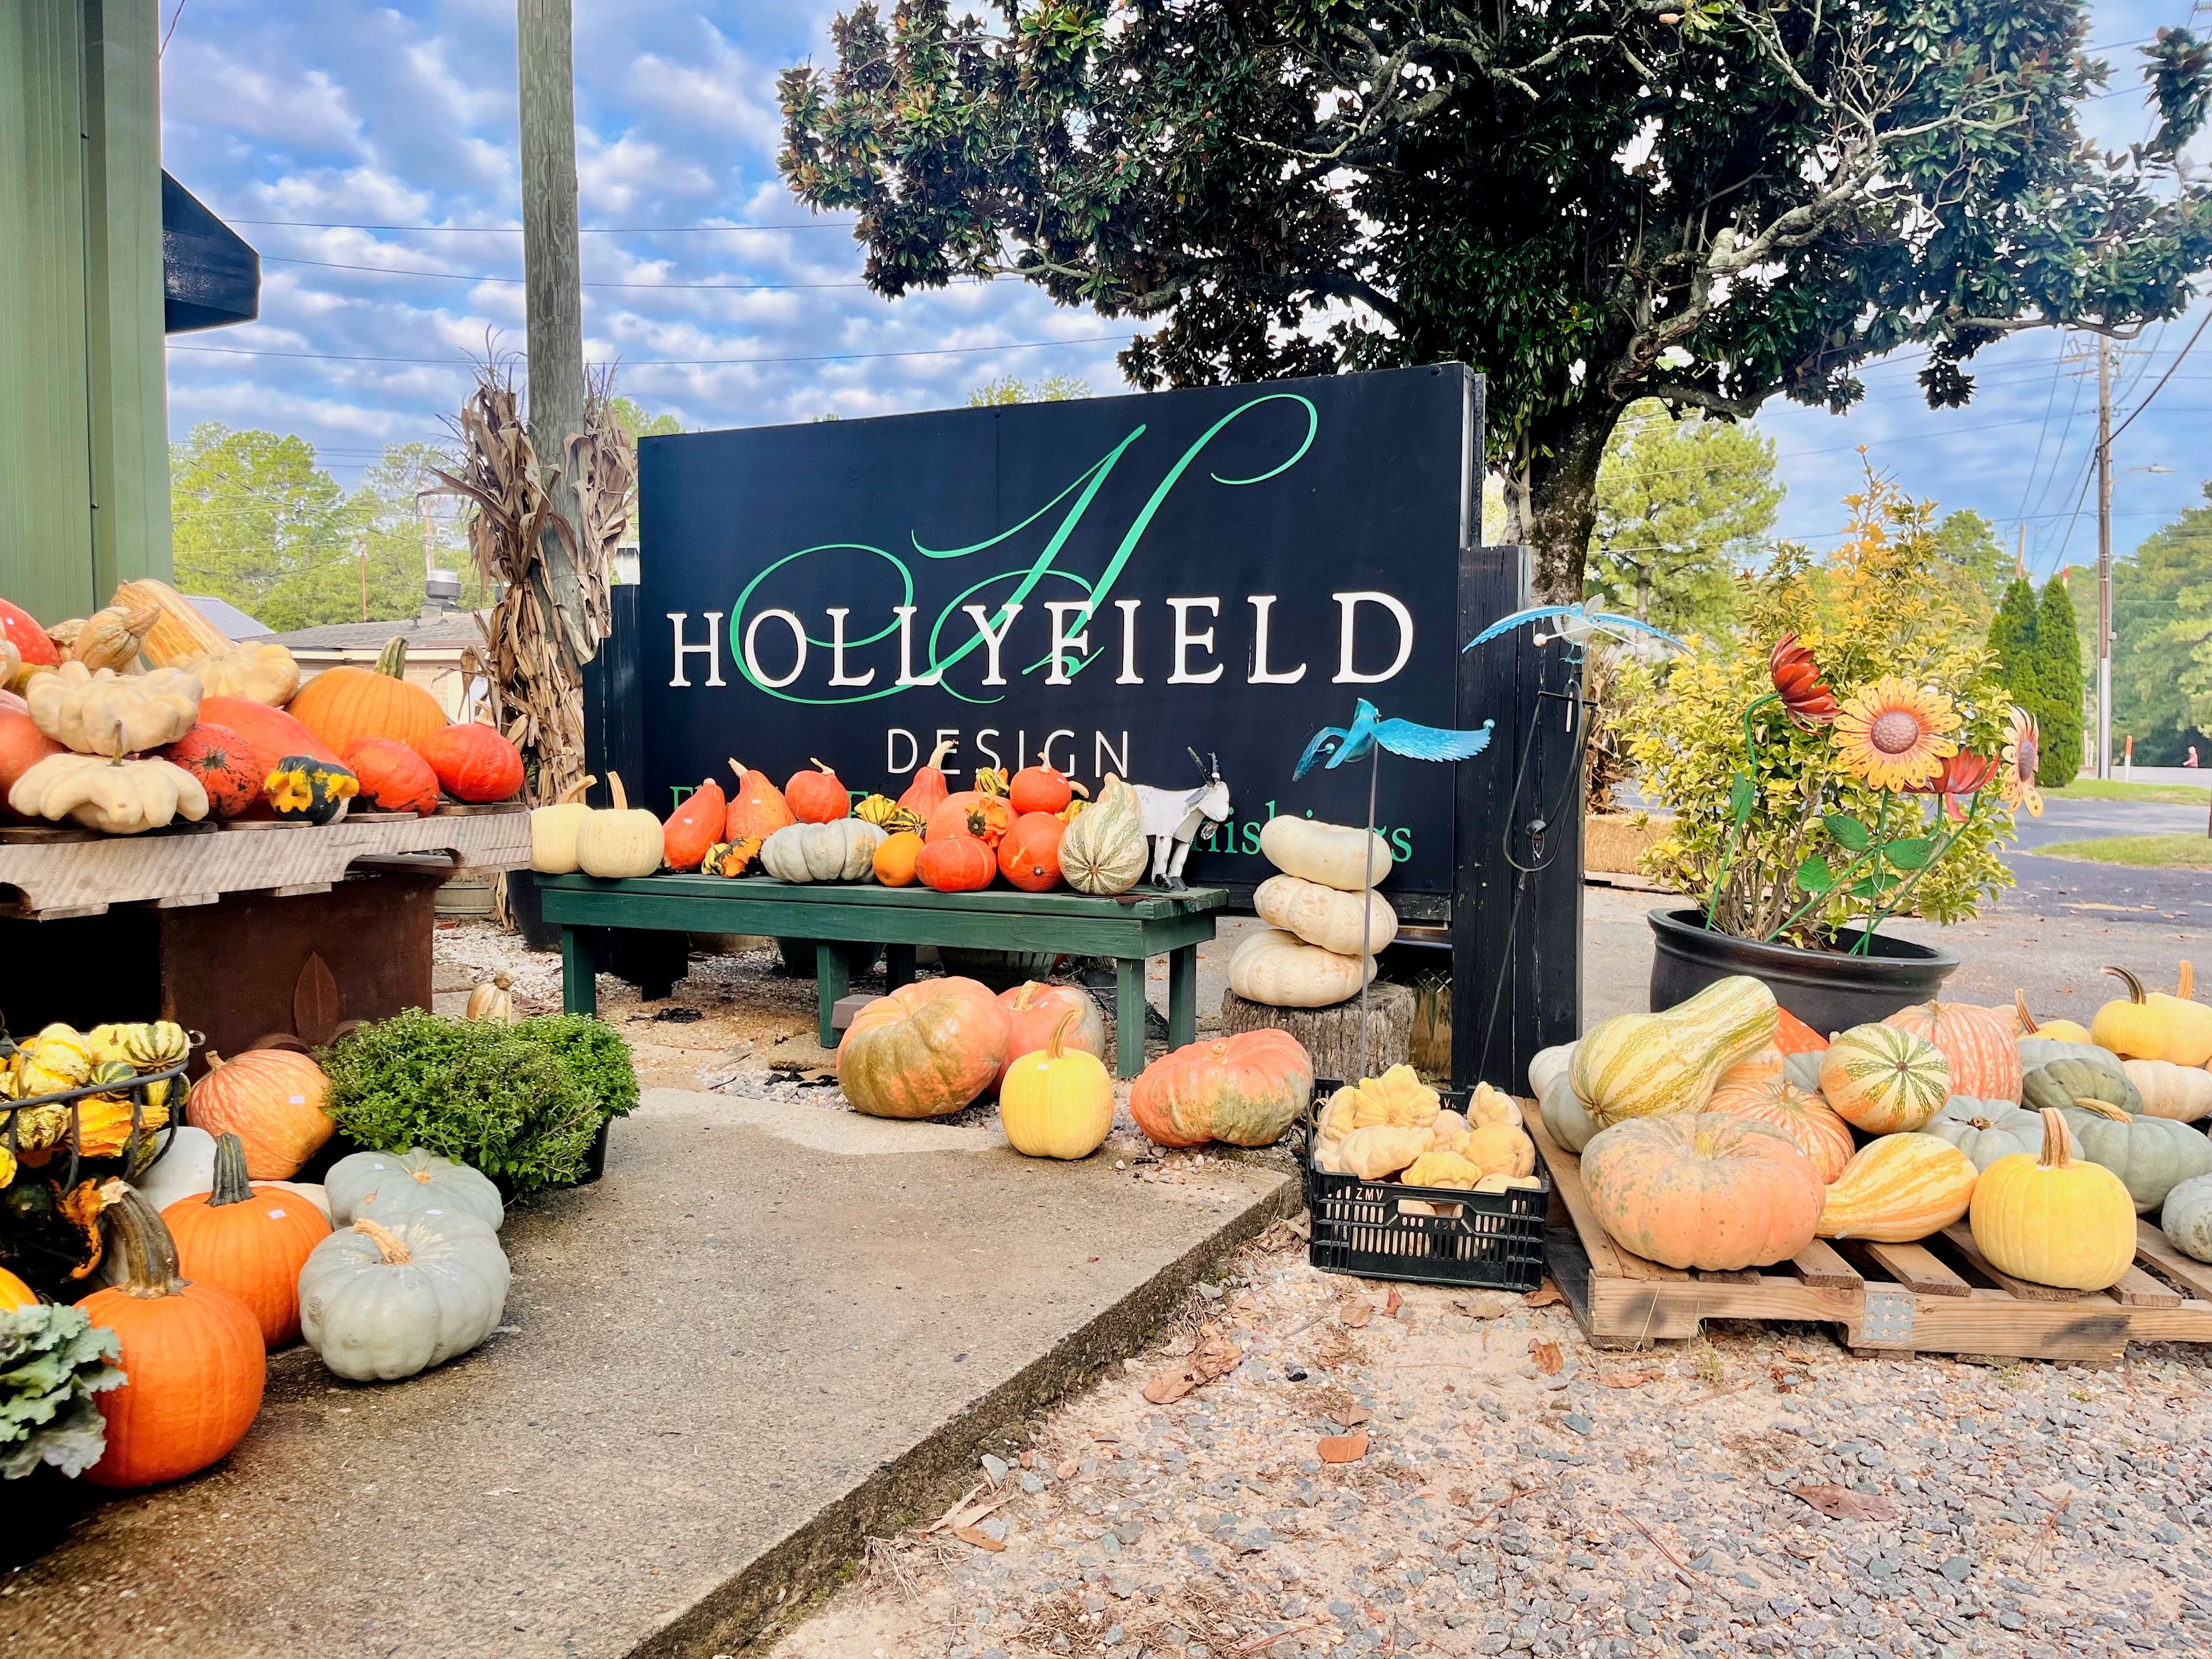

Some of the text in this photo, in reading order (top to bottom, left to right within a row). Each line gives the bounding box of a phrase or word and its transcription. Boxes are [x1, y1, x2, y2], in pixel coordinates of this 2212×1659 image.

[666, 591, 1414, 688] HOLLYFIELD
[887, 728, 1129, 779] DESIGN
[1355, 1187, 1384, 1201] ZMV
